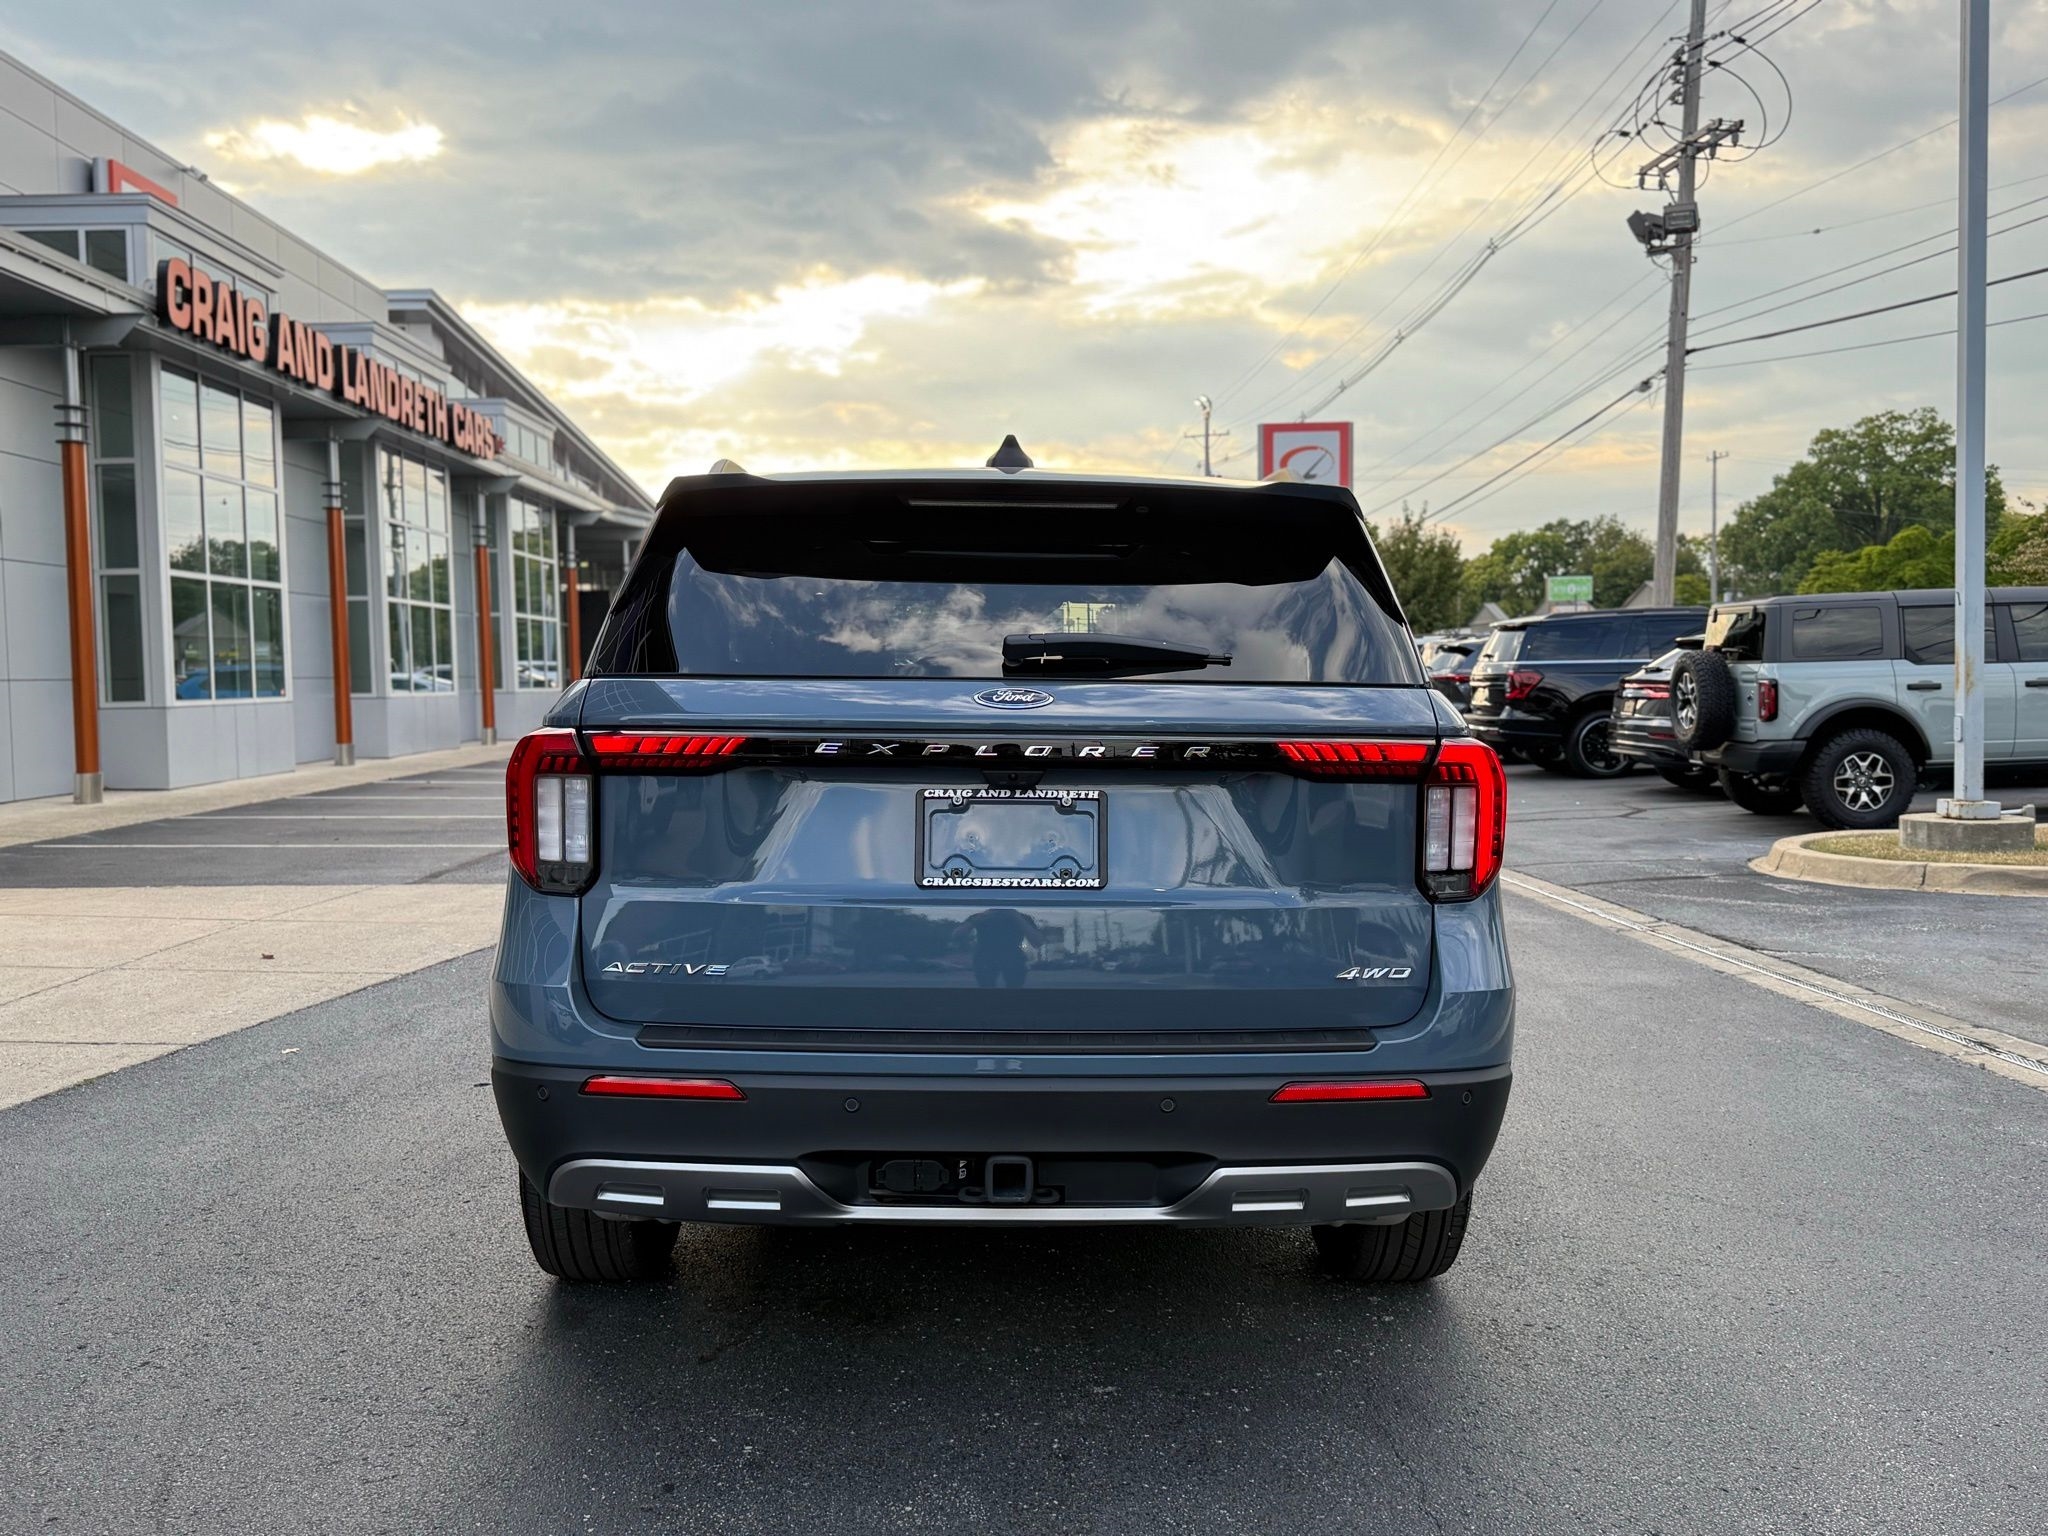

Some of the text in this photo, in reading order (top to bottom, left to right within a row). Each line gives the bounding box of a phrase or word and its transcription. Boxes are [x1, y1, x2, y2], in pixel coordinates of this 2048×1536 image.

[166, 257, 496, 460] CRAIG AND LANDRETH CARS
[993, 690, 1035, 702] Ford
[814, 741, 1213, 759] EXPLORER
[923, 789, 1100, 799] CRAIG AND LANDRETH
[922, 877, 1101, 887] CRAIGSBESTCARS.COM
[602, 961, 730, 976] ACTIVE
[1336, 966, 1412, 979] 4WD
